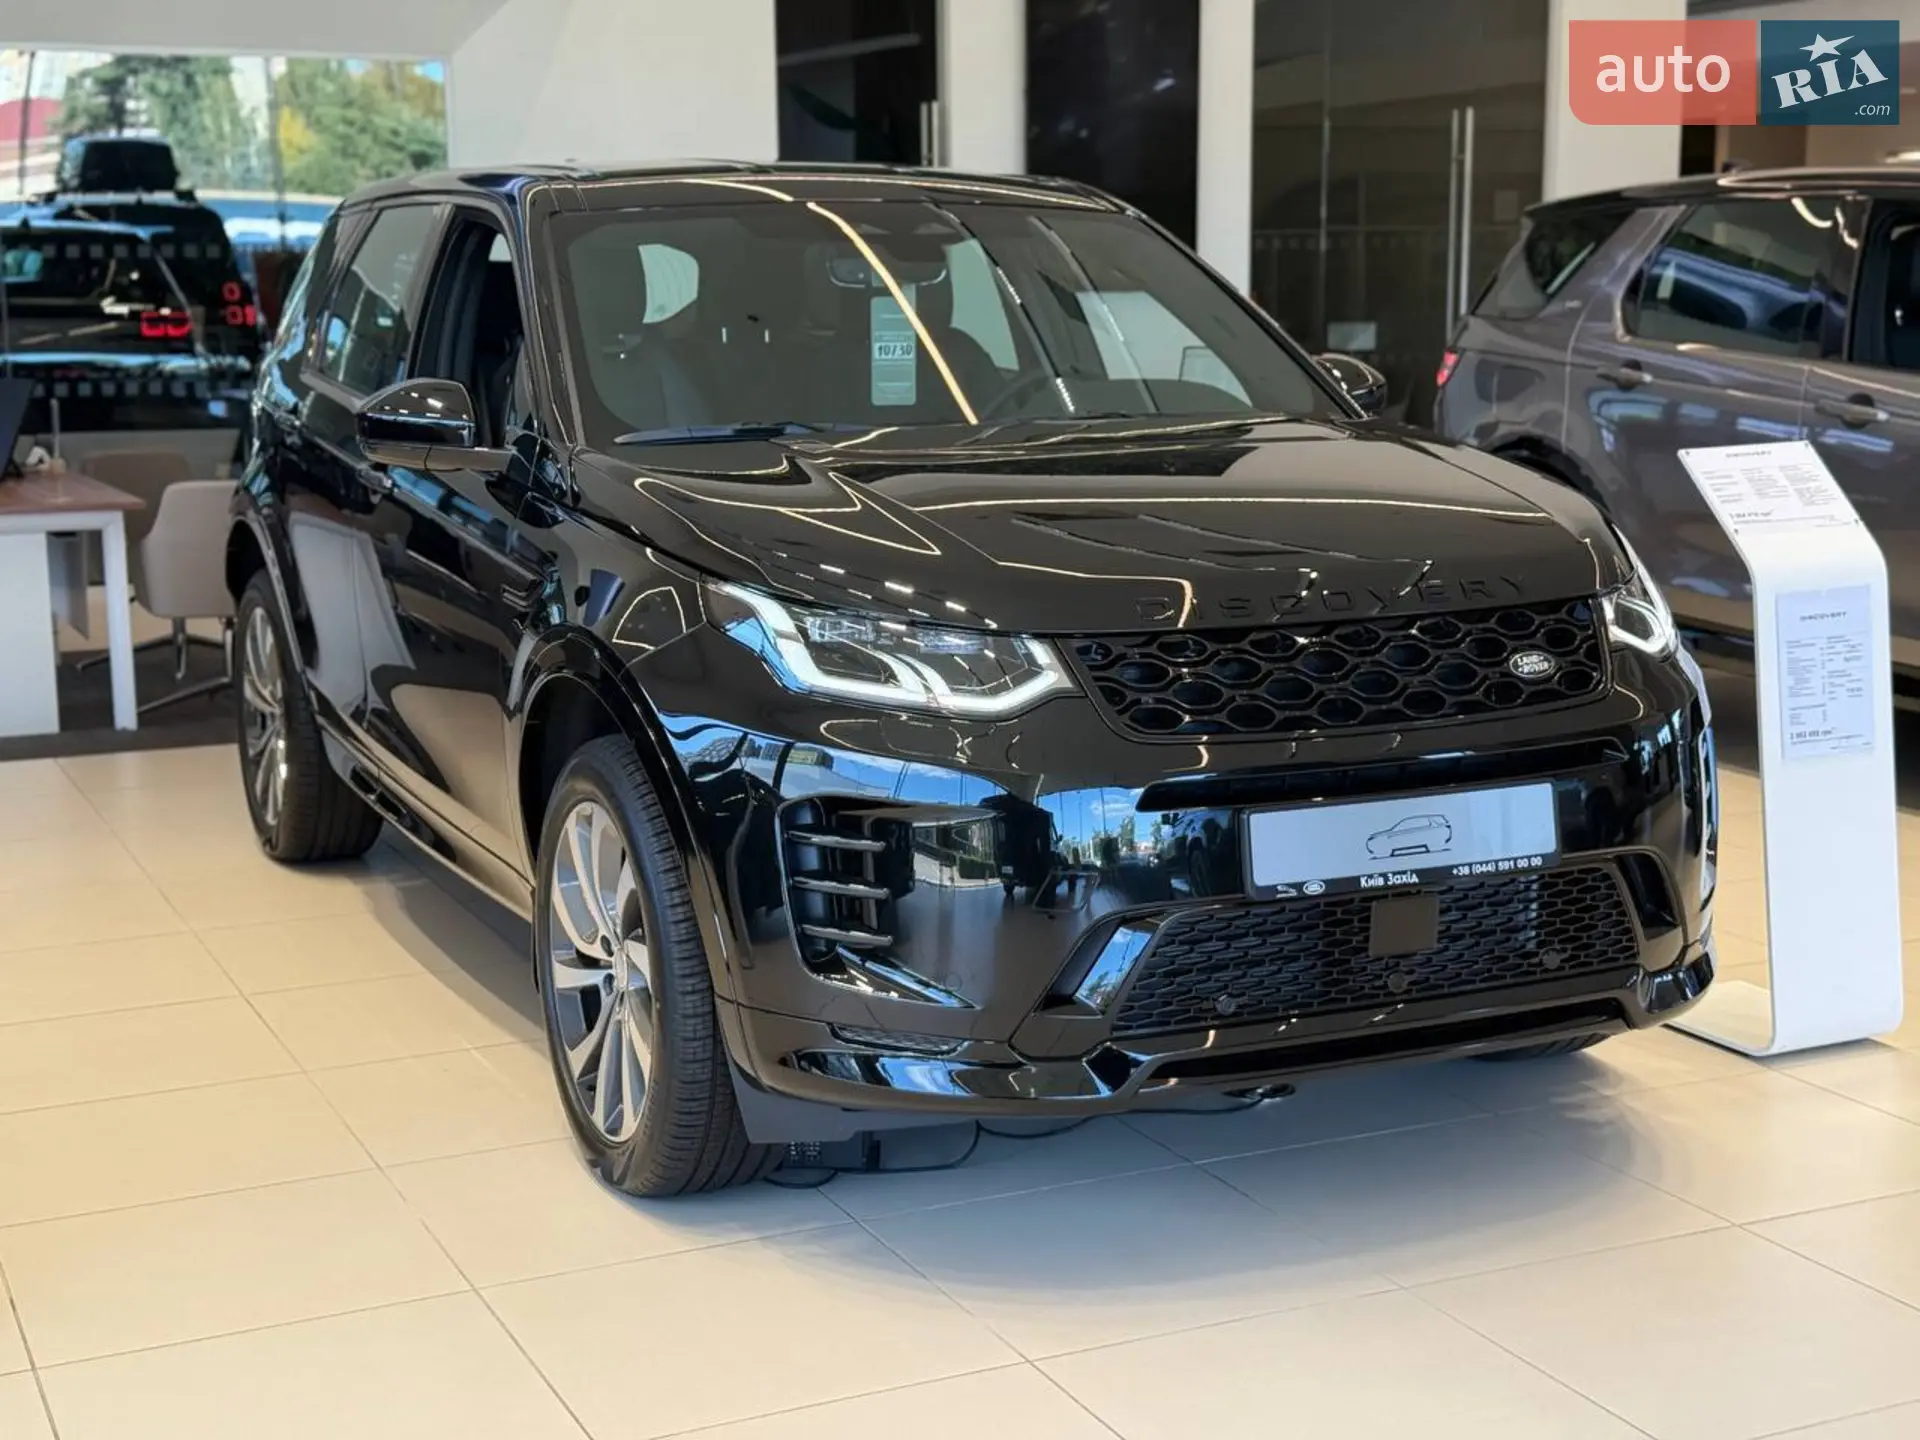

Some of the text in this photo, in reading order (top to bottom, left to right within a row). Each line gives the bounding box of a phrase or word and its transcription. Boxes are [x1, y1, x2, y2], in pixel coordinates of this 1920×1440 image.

[1452, 865, 1470, 876] +38
[1472, 862, 1496, 875] (044)
[1516, 857, 1529, 868] 00
[1530, 856, 1543, 866] 00
